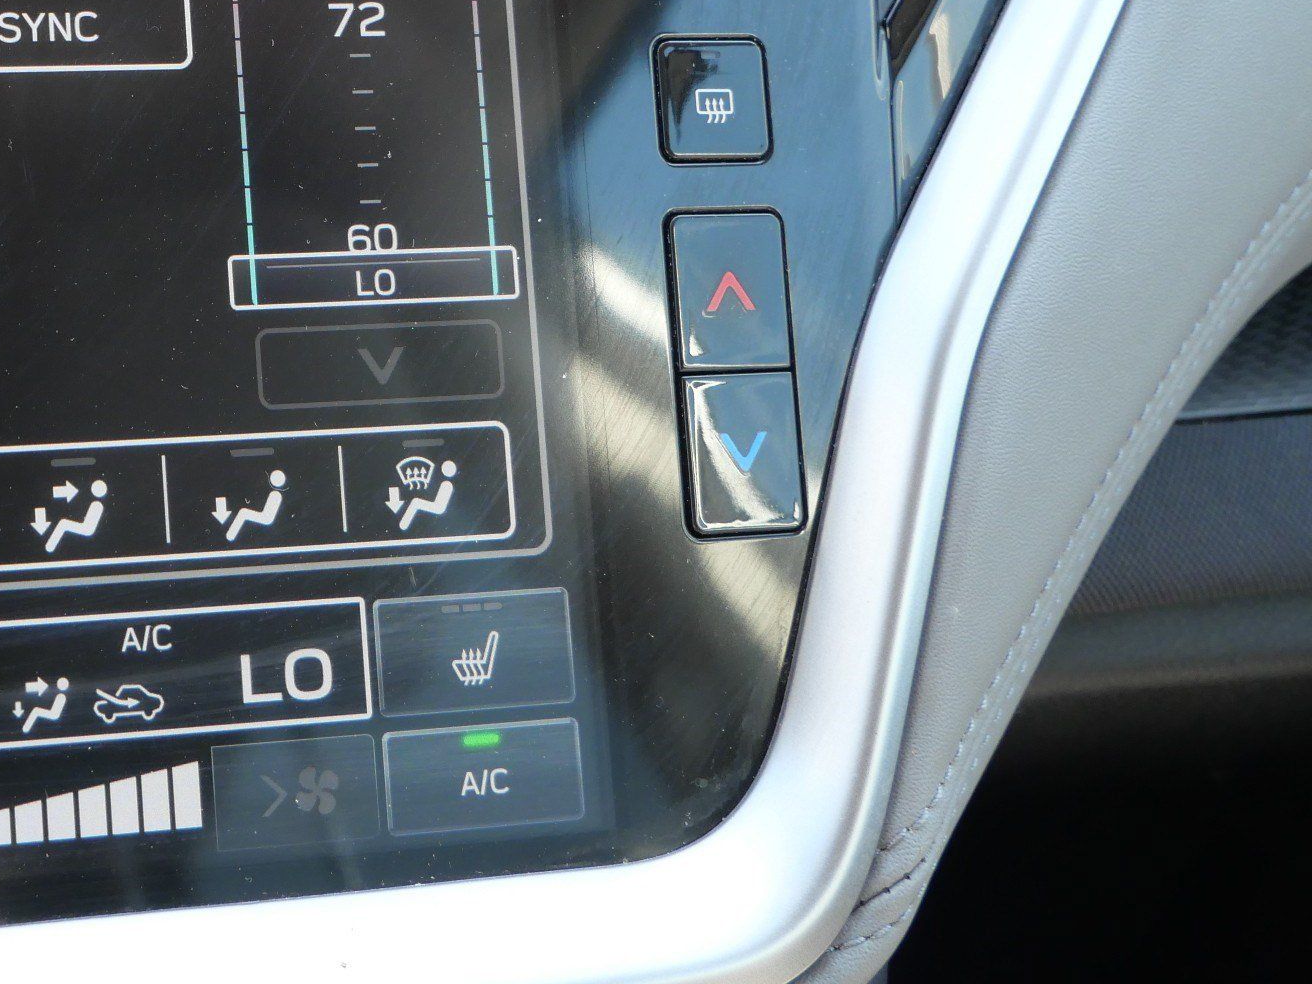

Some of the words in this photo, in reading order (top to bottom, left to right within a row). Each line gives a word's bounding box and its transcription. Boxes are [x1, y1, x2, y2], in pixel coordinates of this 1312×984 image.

[328, 2, 385, 37] 72
[347, 223, 398, 251] 60
[356, 269, 395, 296] LO
[122, 624, 172, 652] A/C
[241, 648, 332, 704] LO
[462, 768, 509, 796] A/C
